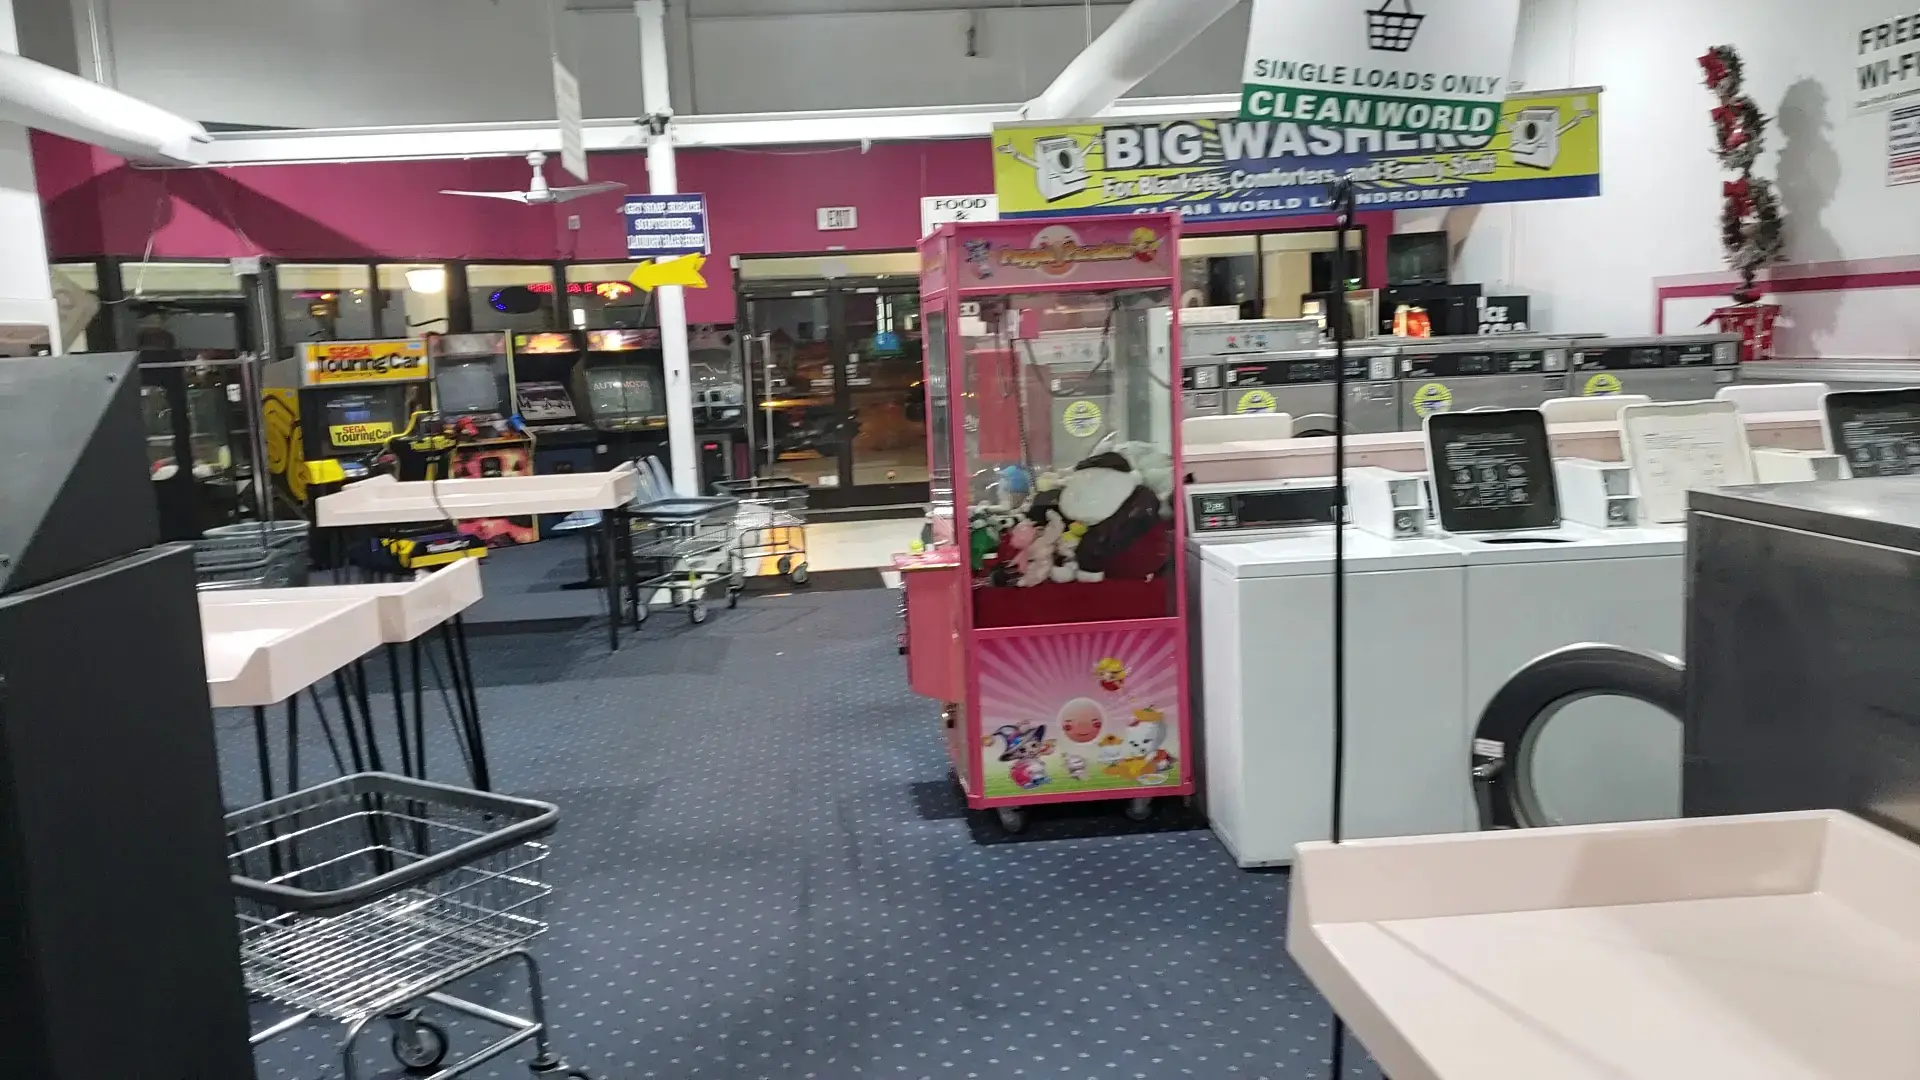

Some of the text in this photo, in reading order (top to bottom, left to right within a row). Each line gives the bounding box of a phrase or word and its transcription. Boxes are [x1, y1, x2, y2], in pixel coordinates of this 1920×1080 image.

[1254, 59, 1501, 95] SINGLE LOADS ONLY
[1248, 91, 1494, 132] CLEAN WORLD
[1105, 124, 1202, 169] BIG
[1103, 177, 1134, 197] For
[934, 198, 987, 210] FOOD
[1219, 198, 1301, 211] WORLD
[593, 380, 622, 391] AUT
[343, 425, 366, 434] SEGA
[335, 430, 376, 443] Touring
